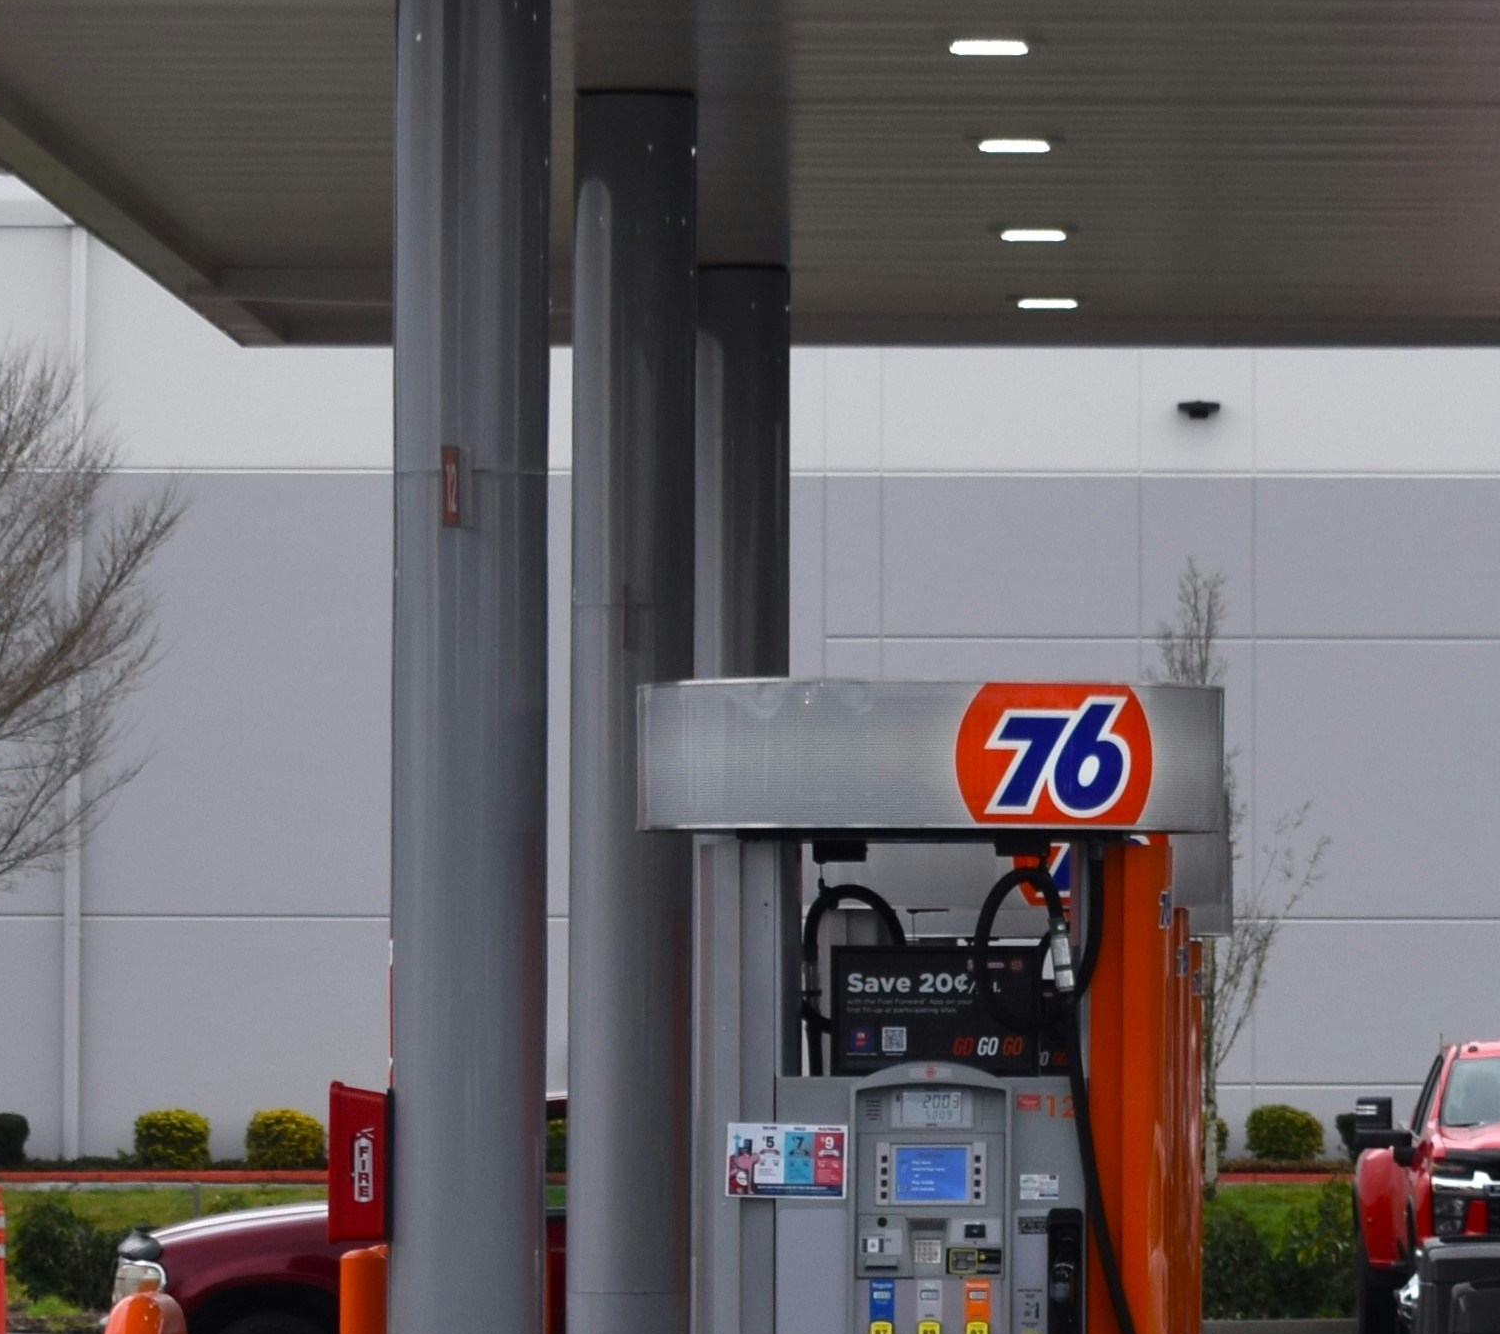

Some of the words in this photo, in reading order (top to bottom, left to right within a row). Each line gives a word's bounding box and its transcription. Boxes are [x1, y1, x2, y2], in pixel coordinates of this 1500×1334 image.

[984, 696, 1132, 819] 76
[846, 972, 911, 993] Save
[951, 1036, 974, 1057] GO
[977, 1036, 999, 1057] GO
[1002, 1036, 1024, 1057] GO
[1039, 1051, 1050, 1067] O
[1046, 1094, 1076, 1119] 12
[358, 1146, 370, 1198] FIRE
